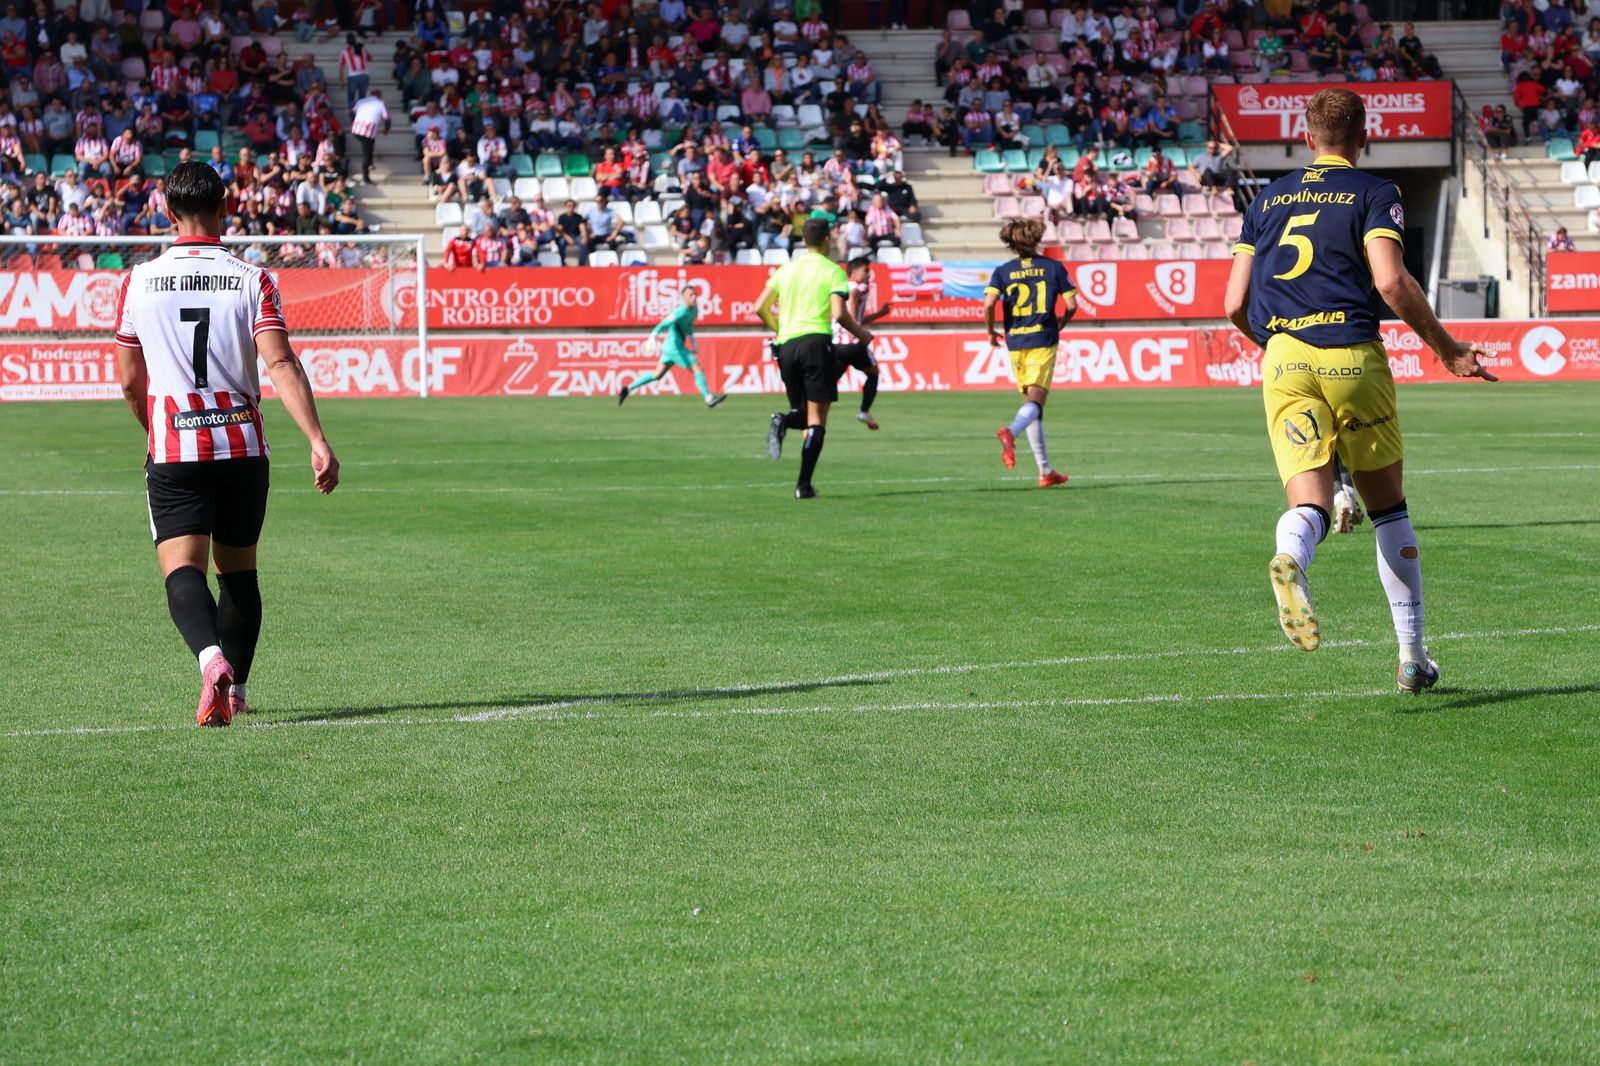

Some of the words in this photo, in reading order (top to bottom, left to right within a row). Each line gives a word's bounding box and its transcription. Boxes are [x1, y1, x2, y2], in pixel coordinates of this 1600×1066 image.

[1238, 85, 1425, 109] CONSTCIONES
[1280, 113, 1391, 138] TAR,
[1272, 209, 1321, 281] 5
[180, 270, 242, 293] MÁRQUEZ
[1091, 270, 1106, 296] 8
[1170, 268, 1185, 295] 8
[1551, 272, 1600, 290] zam
[397, 287, 499, 308] CNTRO
[503, 282, 595, 306] ÓPTICO
[1006, 280, 1047, 317] 21
[442, 306, 552, 325] ROBERTO
[890, 305, 985, 319] AYUNTAMIENTO
[31, 347, 101, 361] bodegas
[179, 307, 210, 389] 7
[963, 338, 1129, 384] ZAORA
[1129, 337, 1189, 383] CF
[401, 346, 462, 392] CF
[1286, 362, 1362, 376] DELGADO
[173, 409, 253, 428] leomotor.net
